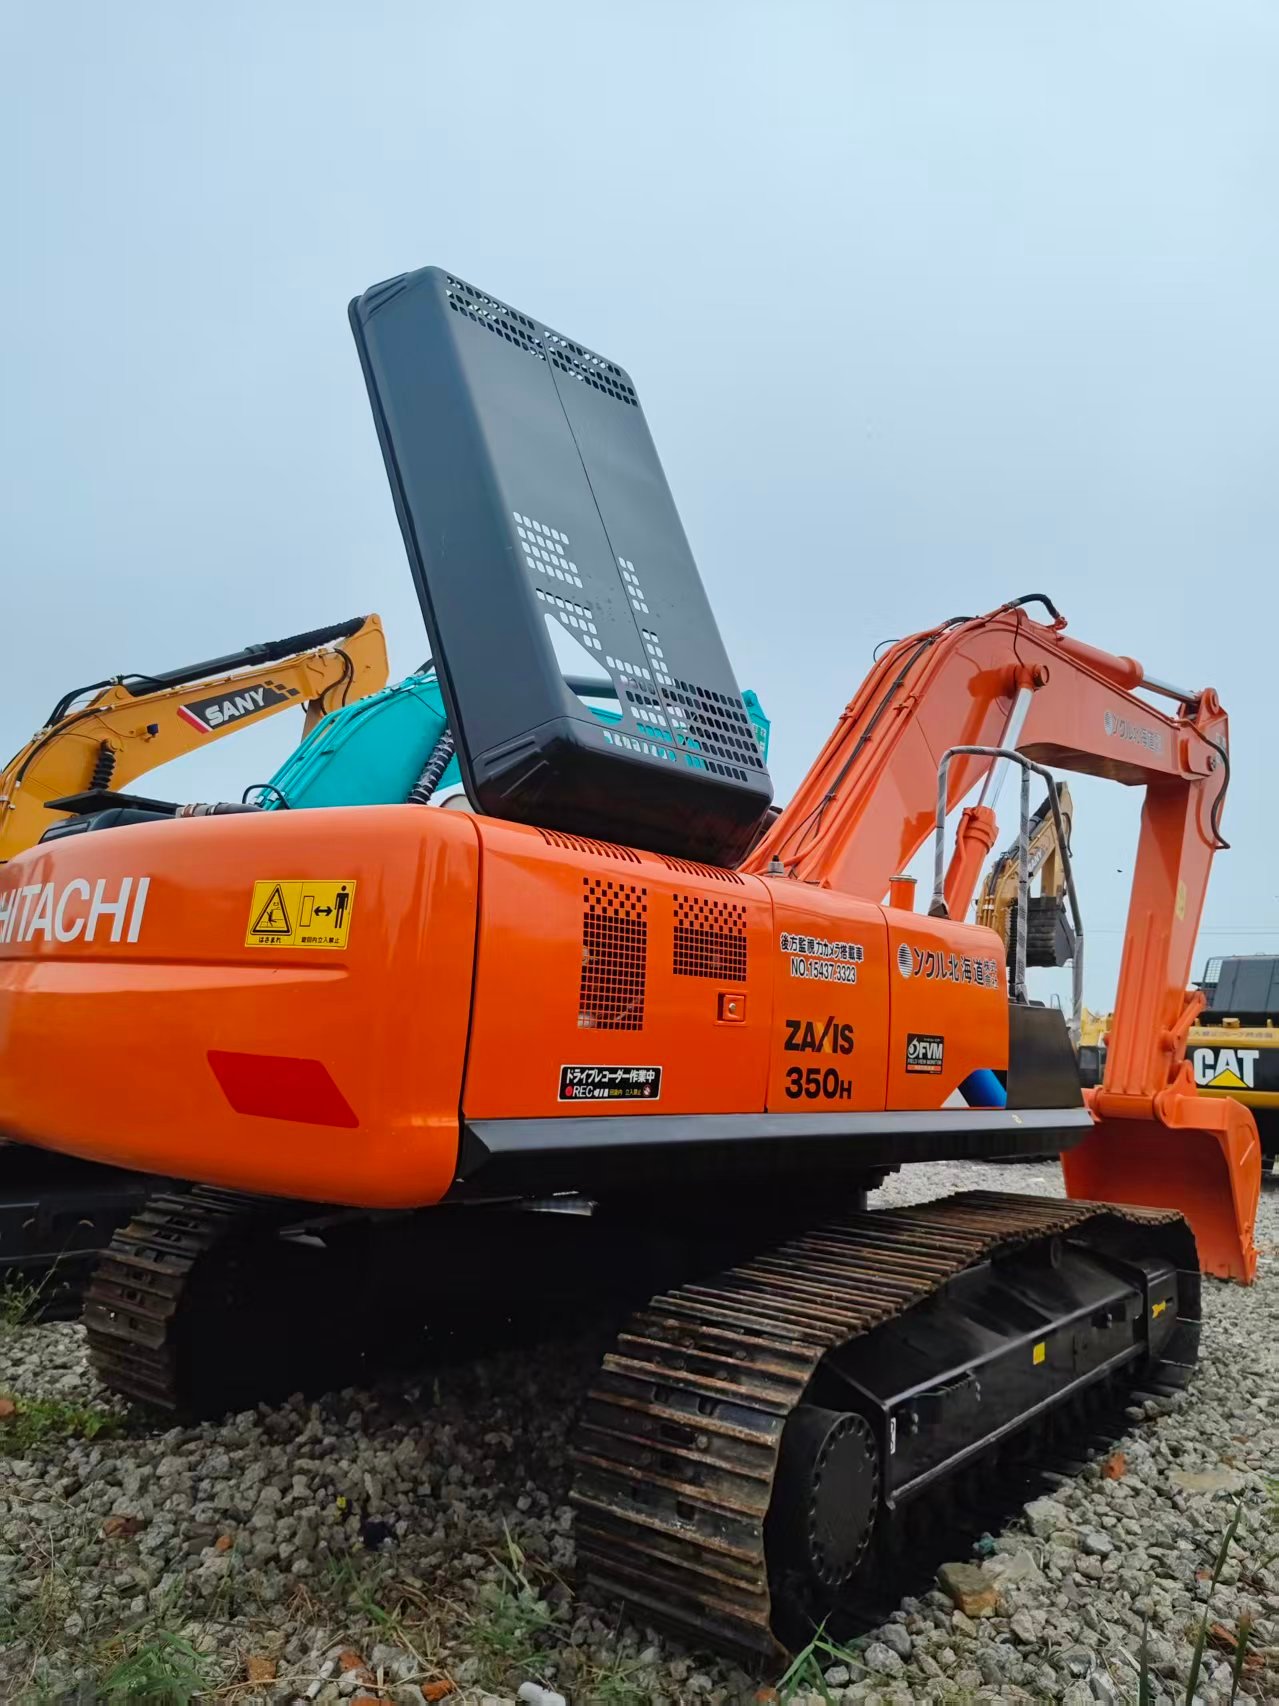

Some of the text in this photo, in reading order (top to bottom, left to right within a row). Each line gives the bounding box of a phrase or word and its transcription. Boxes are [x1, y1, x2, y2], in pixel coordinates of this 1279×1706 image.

[205, 688, 264, 726] SANY
[0, 877, 151, 943] HITACHI
[784, 1015, 854, 1055] ZAXIS
[919, 1041, 943, 1060] FVM
[1193, 1048, 1260, 1089] CAT
[573, 1085, 594, 1097] REC
